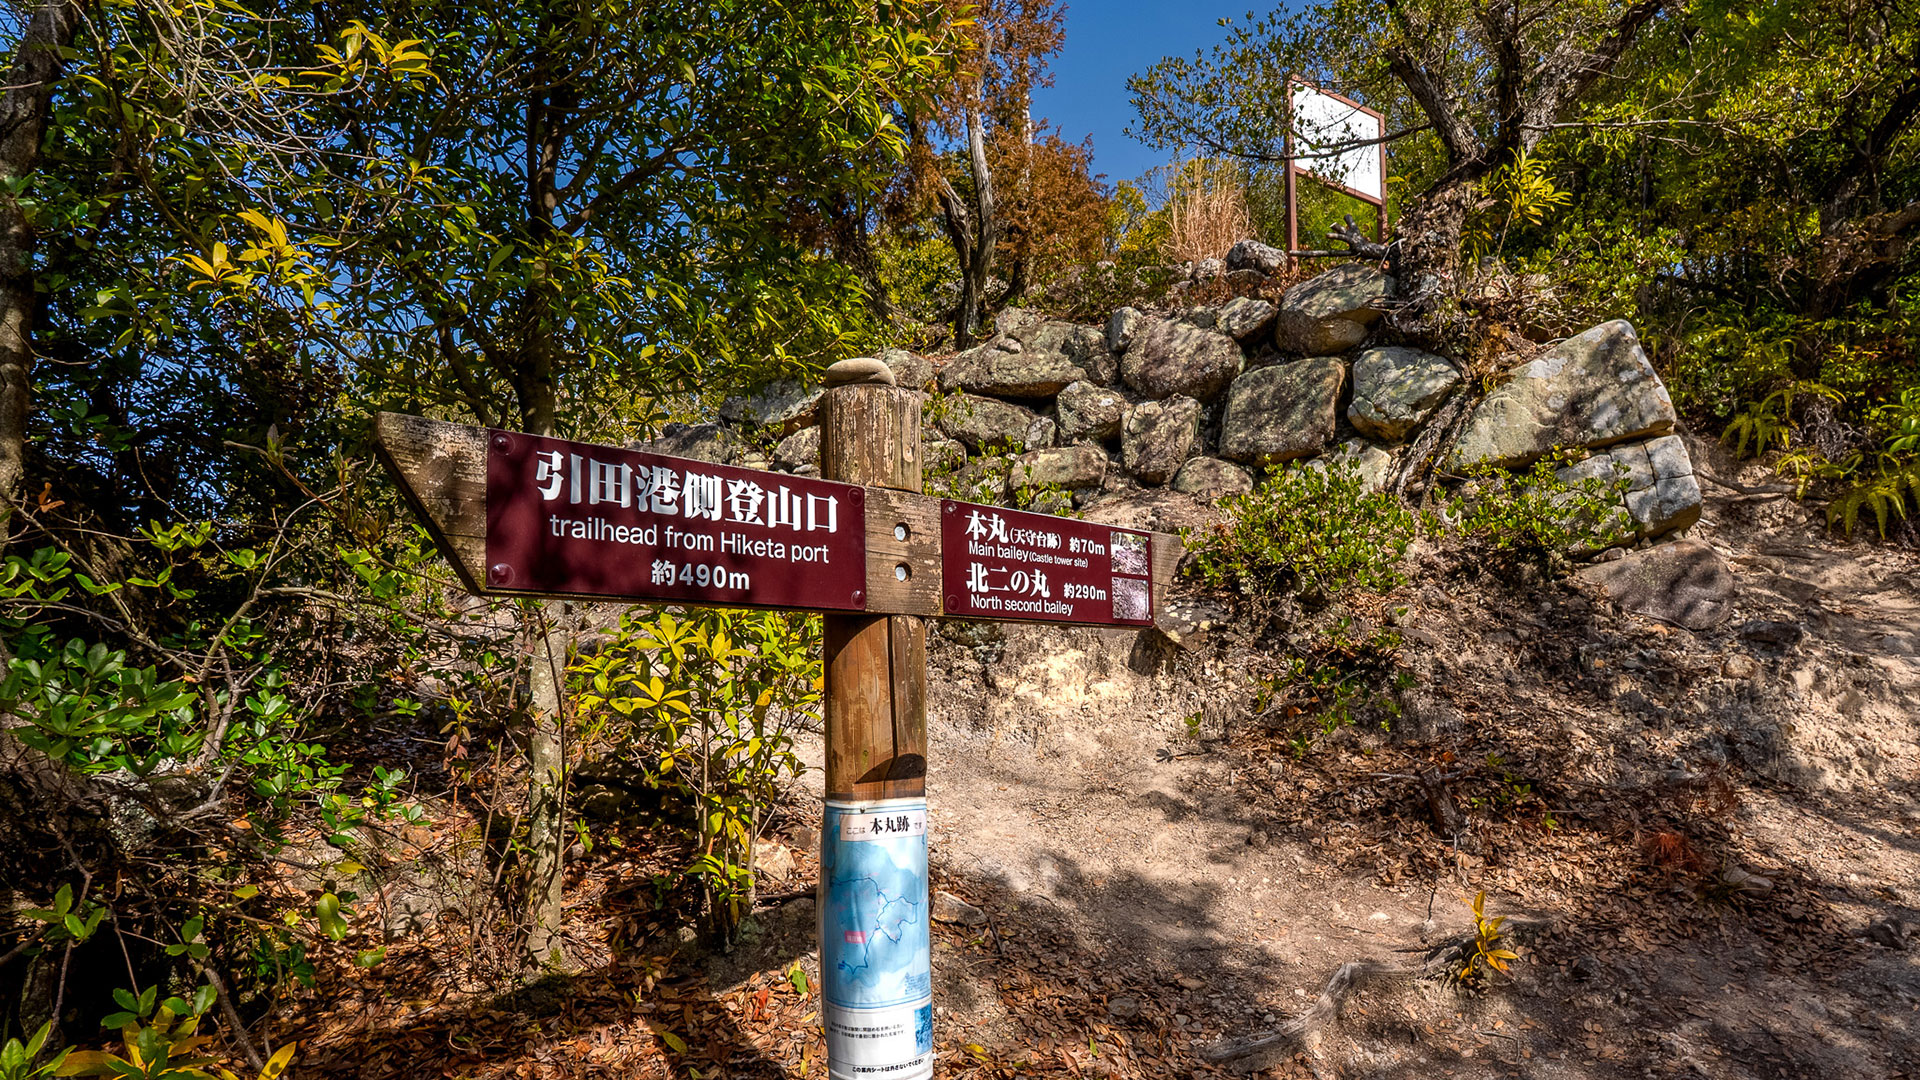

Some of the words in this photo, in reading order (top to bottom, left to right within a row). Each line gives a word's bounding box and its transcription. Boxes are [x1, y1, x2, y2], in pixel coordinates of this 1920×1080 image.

[536, 450, 838, 533] 引田港側登山口
[550, 515, 657, 546] trailhead
[665, 525, 714, 552] from
[720, 532, 785, 559] Hiketa
[791, 543, 829, 564] port
[1069, 537, 1105, 555] 約70m
[969, 541, 995, 557] Main
[1054, 555, 1073, 566] tower
[1074, 558, 1088, 568] site)
[651, 559, 750, 591] 約490m
[966, 562, 1050, 598] 北二の丸
[1063, 582, 1106, 600] 約290m
[970, 594, 1002, 612] North
[1005, 597, 1042, 613] second
[1044, 600, 1073, 616] bailey
[870, 815, 910, 835] 本丸跡
